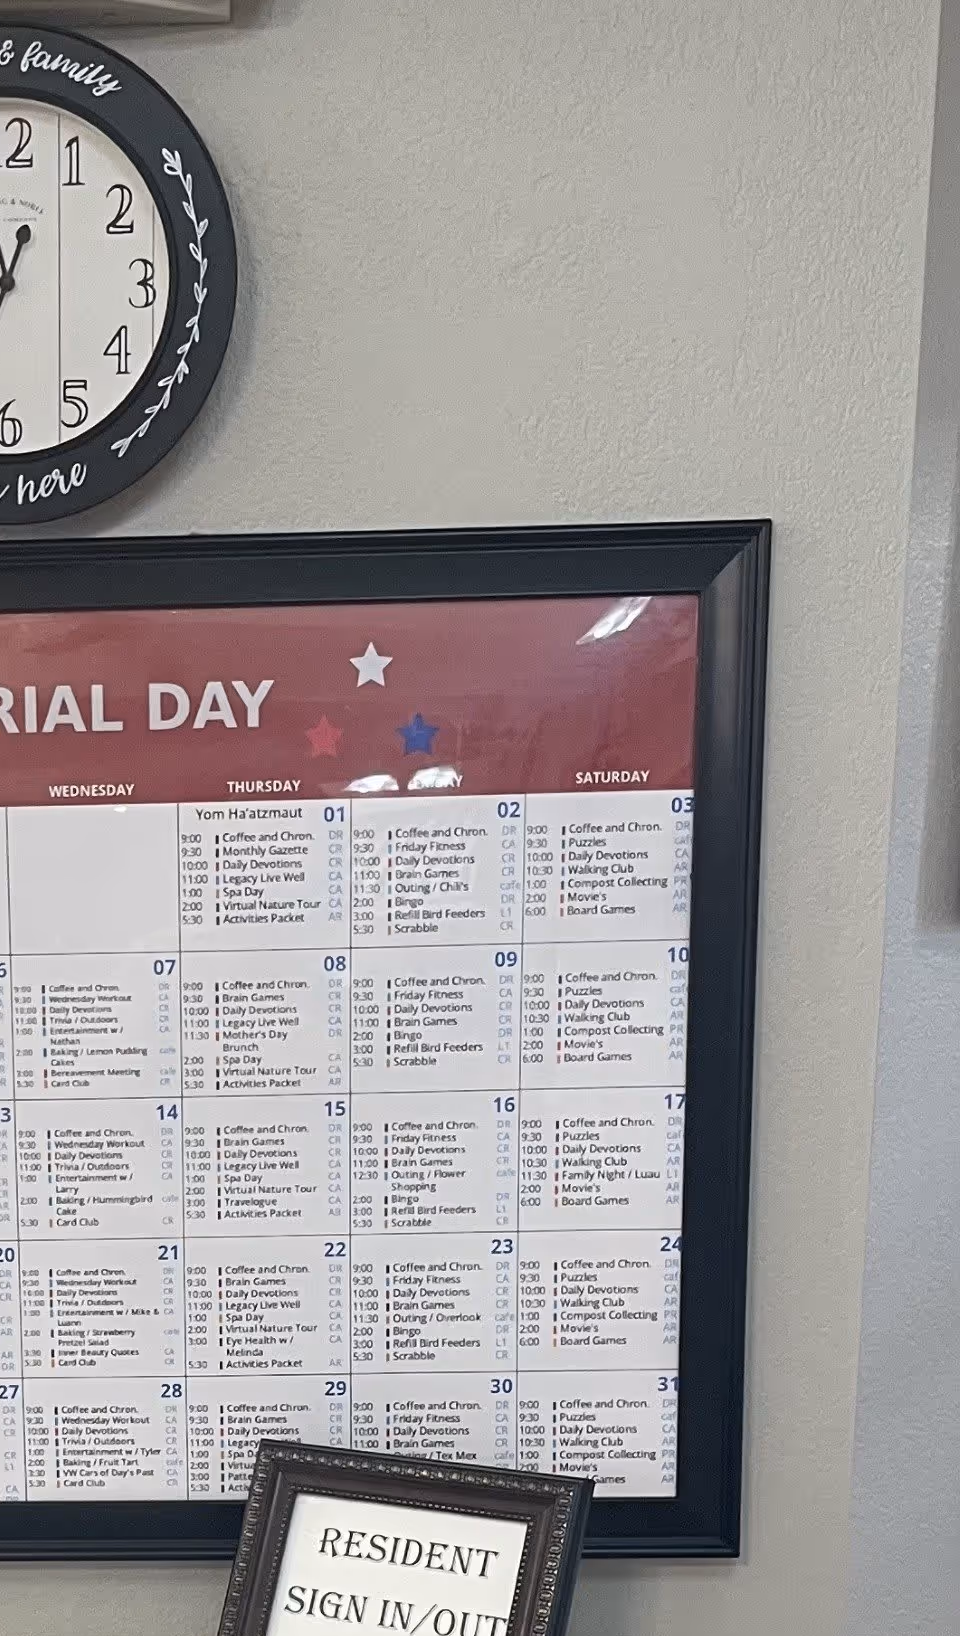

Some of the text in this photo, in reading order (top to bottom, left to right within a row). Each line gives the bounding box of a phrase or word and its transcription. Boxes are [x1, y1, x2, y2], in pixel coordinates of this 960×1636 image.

[20, 41, 122, 97] family
[62, 136, 86, 186] 1
[105, 183, 135, 235] 2
[127, 257, 157, 309] 3
[104, 325, 132, 376] 4
[61, 379, 89, 428] 5
[17, 462, 87, 505] here
[147, 679, 274, 732] DAY
[575, 771, 649, 784] SATURDAY
[48, 783, 135, 798] WEDNESDAY
[226, 779, 301, 794] THURSDAY
[498, 801, 520, 818] 02
[671, 797, 694, 813] 03
[196, 807, 224, 820] Yom
[324, 806, 345, 822] 01
[223, 832, 255, 843] Coffee
[259, 832, 278, 842] and
[527, 825, 548, 835] 9:00
[569, 836, 606, 848] Puzzles
[223, 845, 308, 857] Monthly Gazette
[568, 863, 634, 875] Walking Club
[568, 876, 668, 889] Compost Collecting
[223, 899, 321, 910] Virtual Nature Tour
[568, 892, 606, 902] Movie's
[567, 905, 635, 915] Board Games
[223, 913, 304, 923] Activities Packet
[495, 952, 517, 967] 09
[668, 947, 688, 962] 10
[153, 960, 176, 975] 07
[324, 956, 346, 971] 08
[394, 989, 463, 1002] Friday Fitness
[394, 1042, 483, 1053] Refill Bird Feeders
[394, 1056, 436, 1066] Scrabble
[325, 1101, 345, 1117] 15
[493, 1097, 515, 1113] 16
[665, 1094, 686, 1109] 17
[156, 1105, 178, 1120] 14
[325, 1242, 346, 1257] 22
[491, 1239, 513, 1254] 23
[661, 1237, 681, 1251] 24
[158, 1245, 178, 1260] 21
[161, 1384, 182, 1398] 28
[325, 1381, 346, 1396] 29
[490, 1379, 513, 1394] 30
[658, 1377, 679, 1391] 31
[319, 1527, 499, 1579] RESIDENT
[284, 1585, 369, 1624] SIGN
